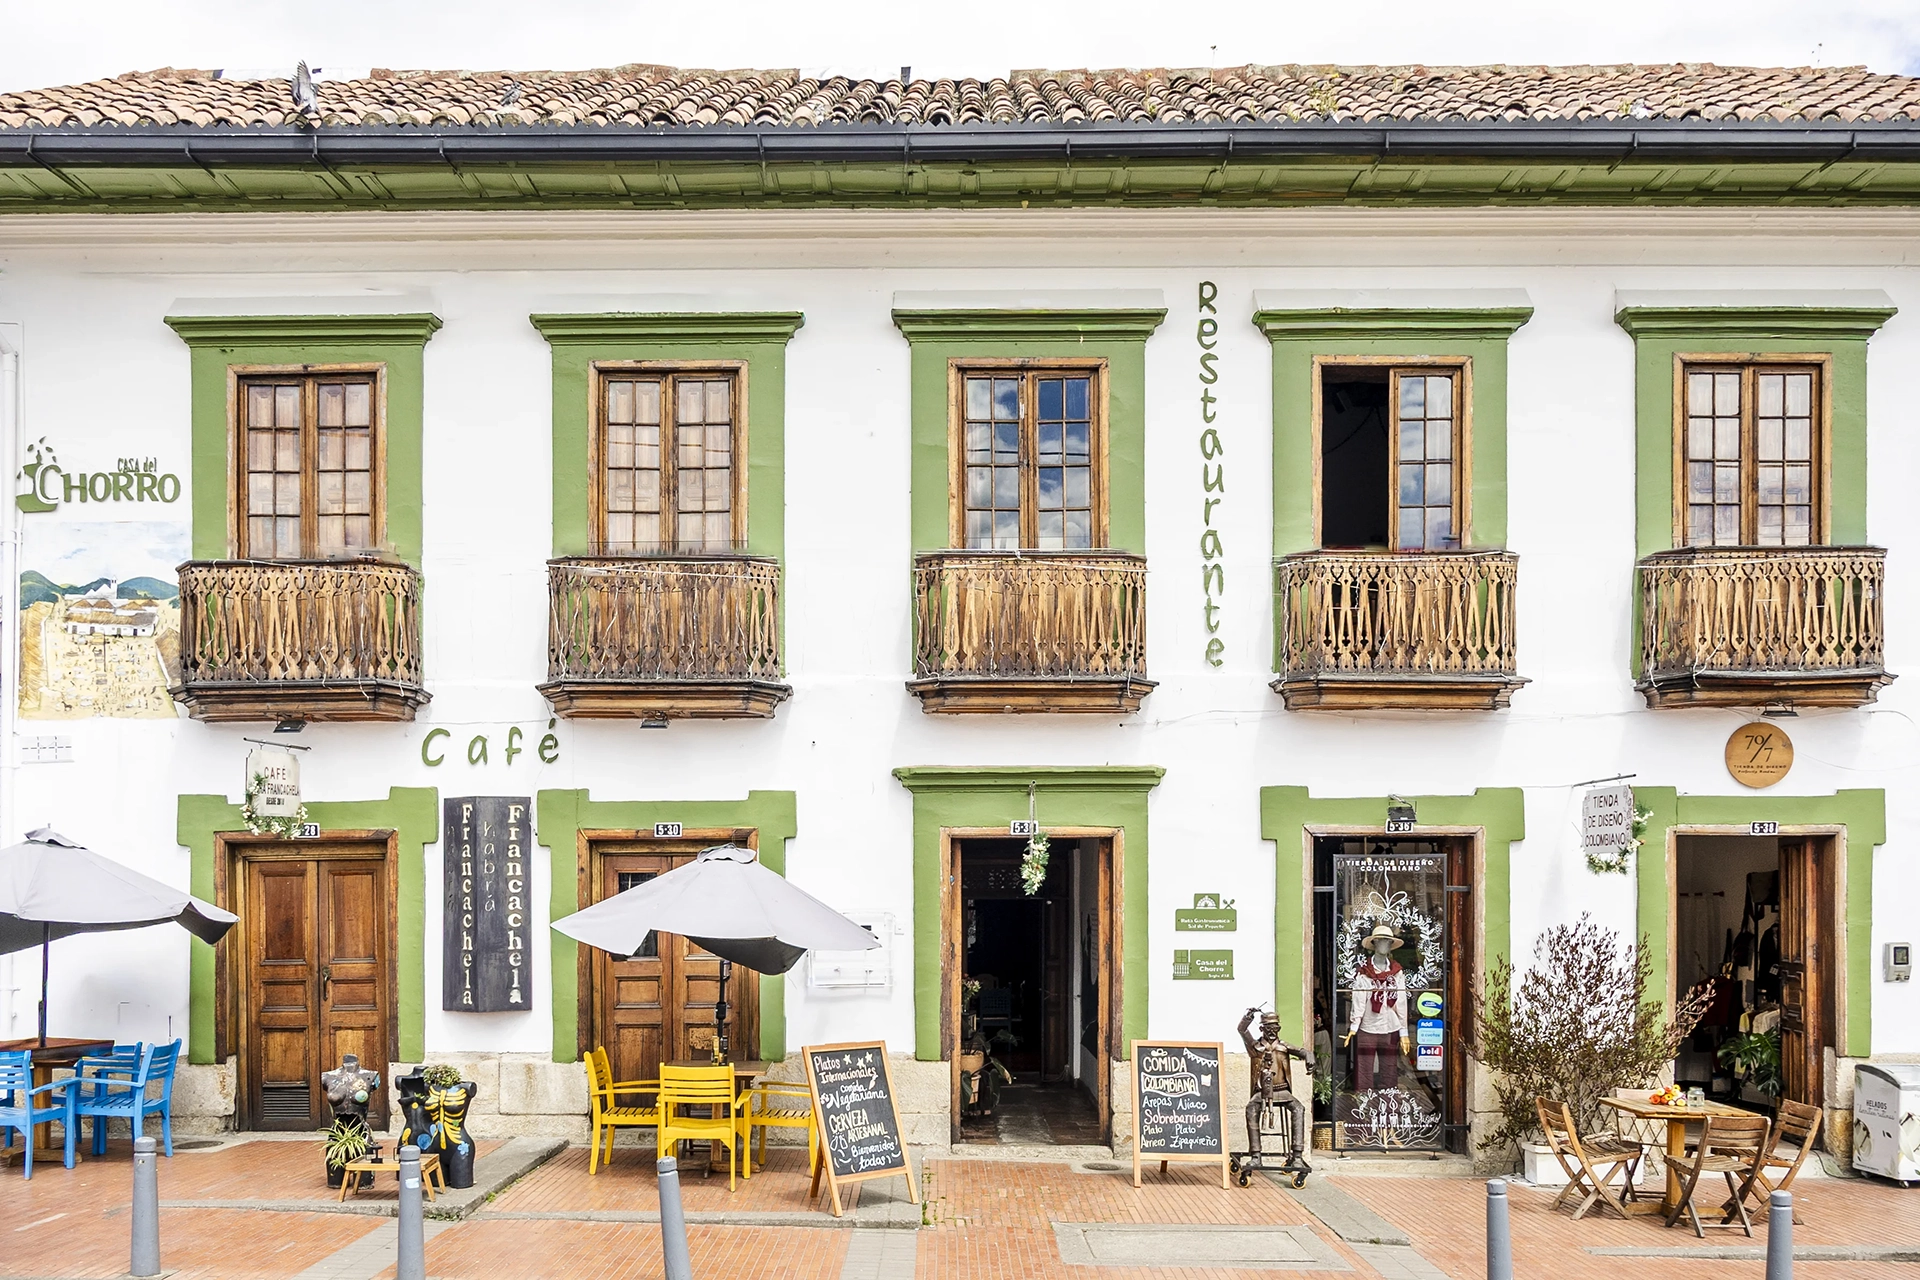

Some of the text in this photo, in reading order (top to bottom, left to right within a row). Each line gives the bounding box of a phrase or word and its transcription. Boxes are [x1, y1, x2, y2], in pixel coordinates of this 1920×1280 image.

[117, 456, 157, 473] CASA del
[1197, 280, 1225, 668] Restaurante
[39, 464, 181, 503] CHORRO
[421, 718, 560, 767] Café
[264, 765, 287, 780] CAFÉ
[267, 783, 300, 796] FRANCACHELA
[1593, 794, 1619, 808] TIENDA
[1588, 810, 1624, 828] DE DISEÑO
[1585, 832, 1626, 847] COLOMBIANO
[462, 803, 474, 1006] Francachela
[507, 805, 524, 1005] Francachela
[1421, 1047, 1440, 1055] bold
[813, 1056, 841, 1072] Platos
[1143, 1056, 1187, 1073] COMIDA
[819, 1065, 878, 1084] Internacionales
[840, 1080, 868, 1093] comida
[1144, 1077, 1195, 1093] COLOMBIANA
[1142, 1096, 1208, 1111] Arepas Ajiaco
[1865, 1099, 1888, 1110] HELADOS
[829, 1108, 869, 1133] CERVEZA
[1144, 1109, 1211, 1128] Sobrebarriga
[847, 1122, 888, 1143] ARTESANAL
[1143, 1124, 1197, 1135] Plato Plato
[851, 1140, 895, 1157] Bienvenidos
[1140, 1135, 1218, 1149] Arriero Zipaquireño
[858, 1154, 886, 1171] todos
